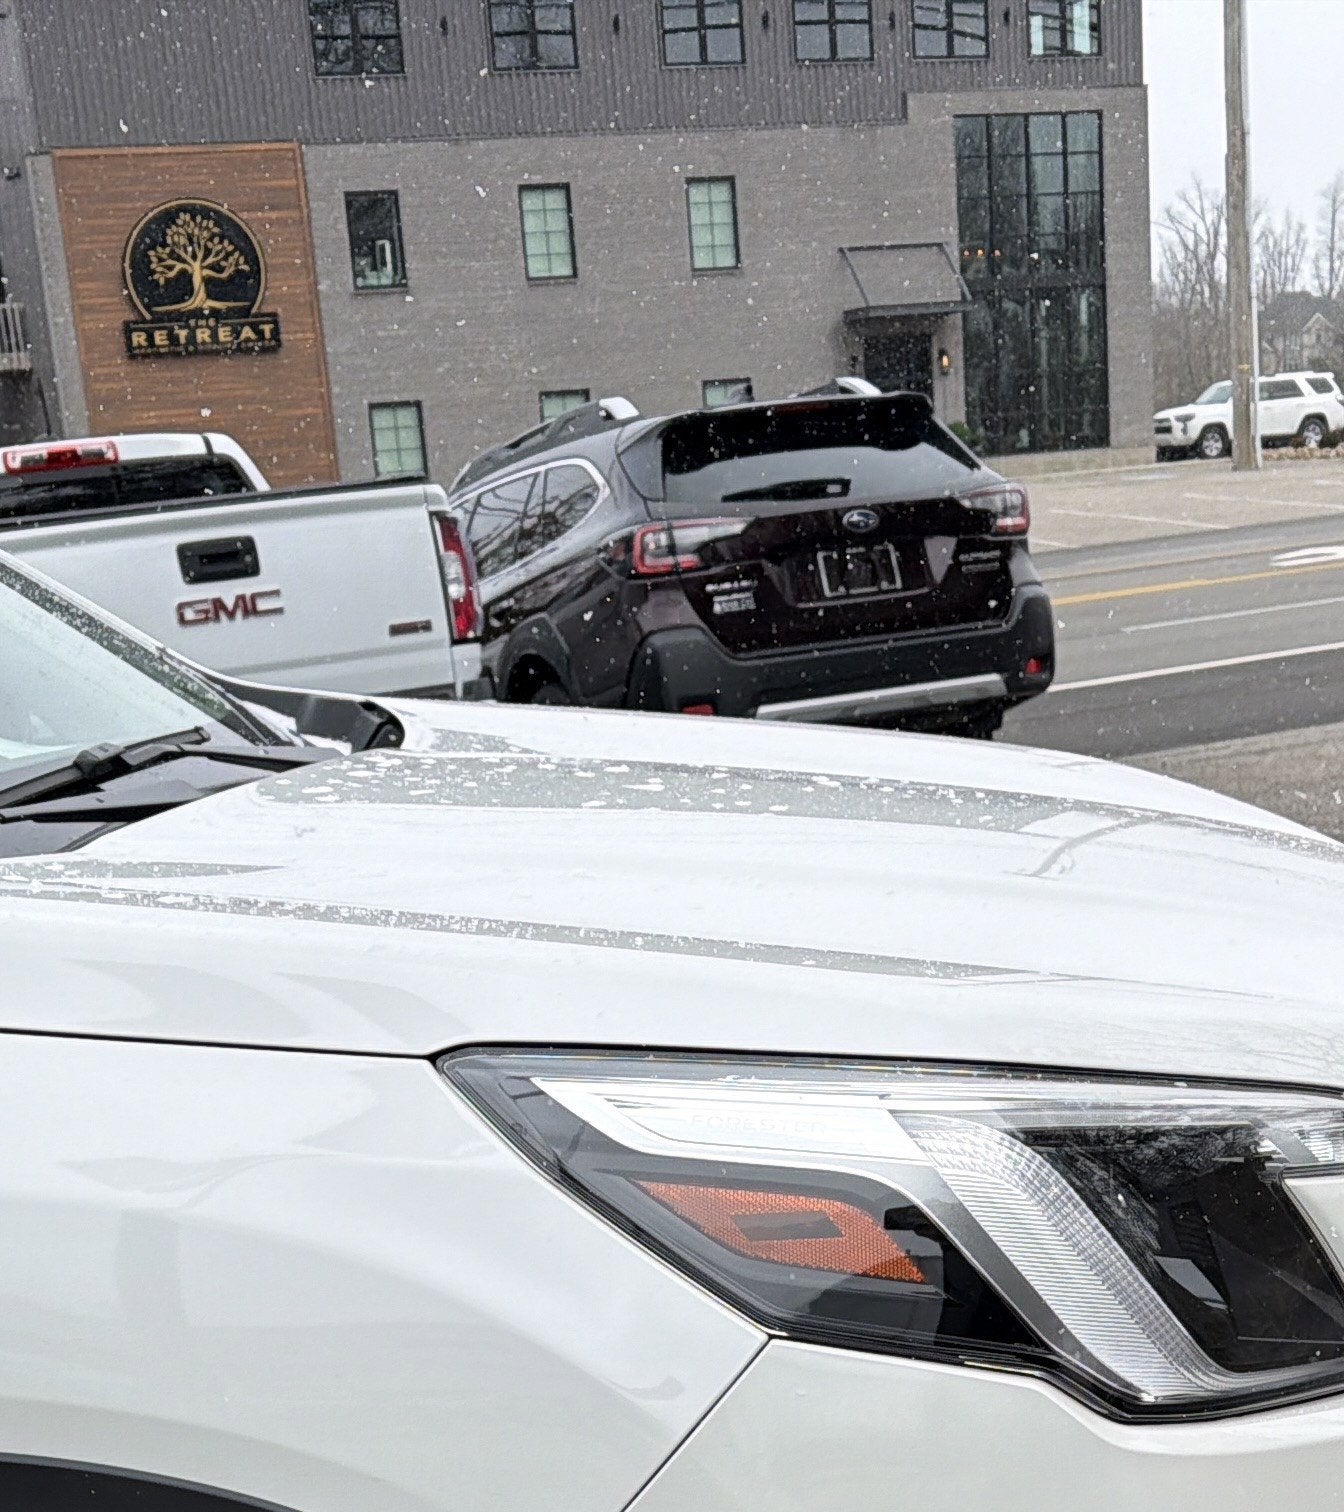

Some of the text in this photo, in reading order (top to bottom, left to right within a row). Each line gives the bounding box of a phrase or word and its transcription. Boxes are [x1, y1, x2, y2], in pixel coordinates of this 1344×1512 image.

[131, 323, 275, 348] RETREAT
[176, 588, 285, 627] GMC
[690, 1113, 828, 1134] FORESTER
